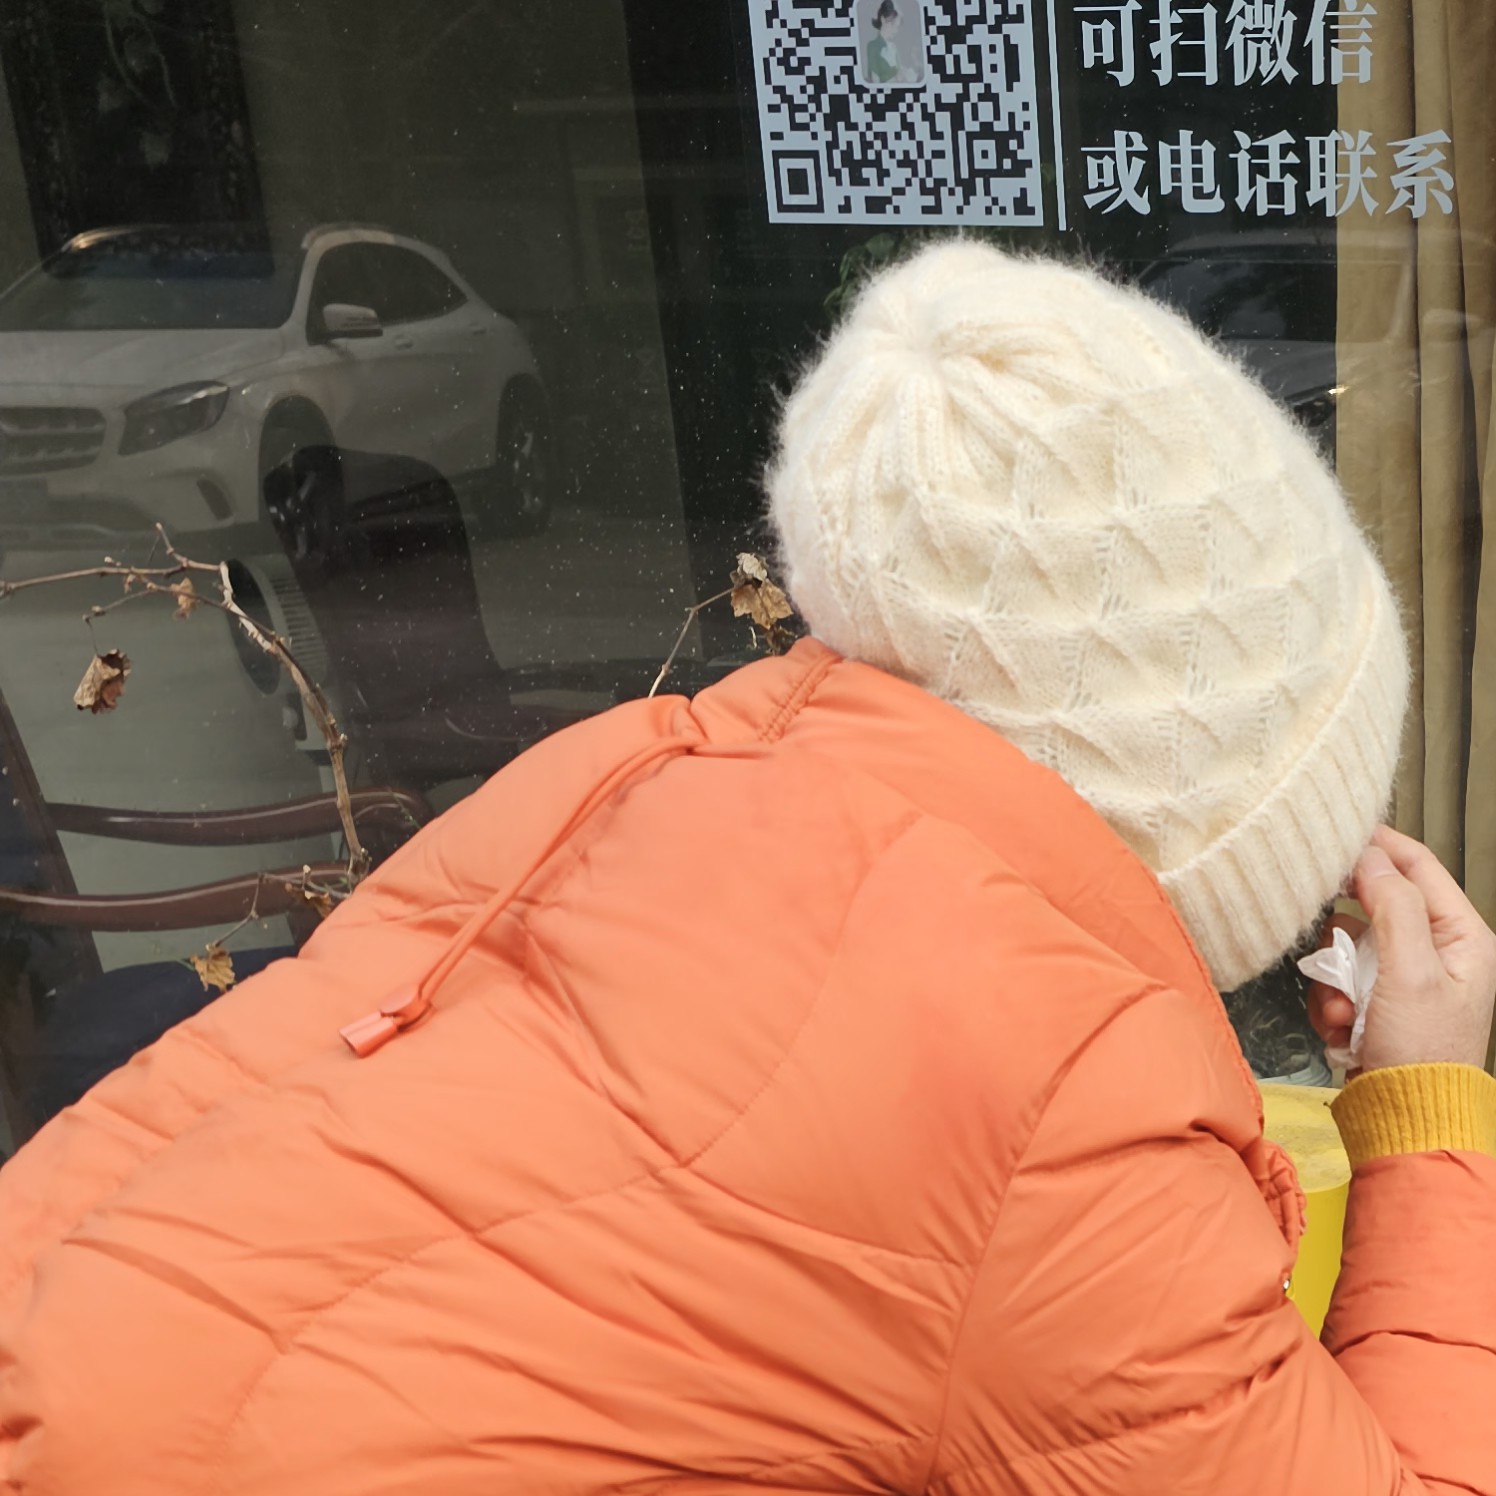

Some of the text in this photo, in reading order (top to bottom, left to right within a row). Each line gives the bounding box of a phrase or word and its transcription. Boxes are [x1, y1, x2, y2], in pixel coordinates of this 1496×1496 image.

[1073, 0, 1378, 87] 可扫微信
[1080, 129, 1455, 218] 或电话联系
